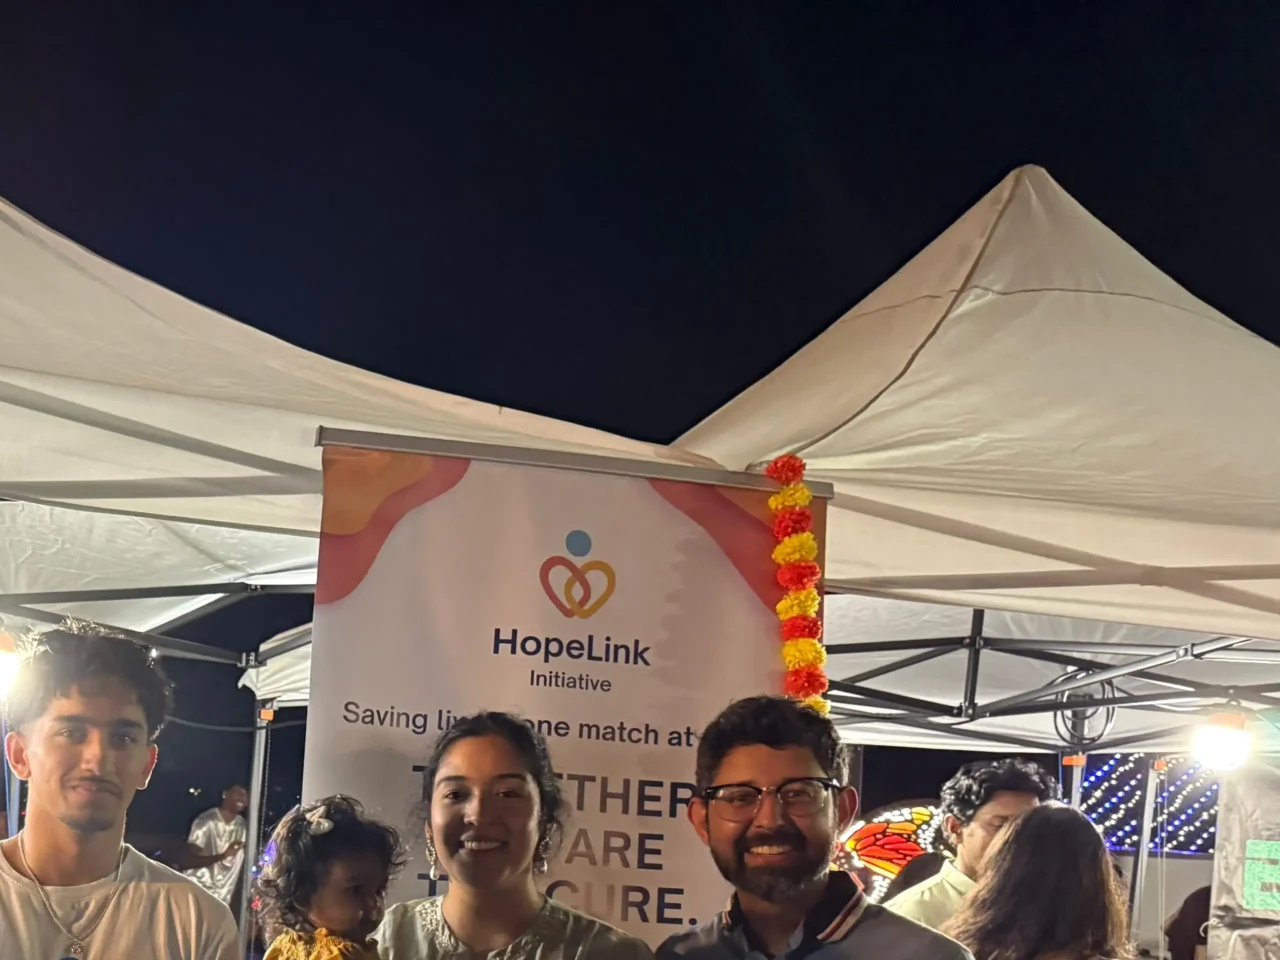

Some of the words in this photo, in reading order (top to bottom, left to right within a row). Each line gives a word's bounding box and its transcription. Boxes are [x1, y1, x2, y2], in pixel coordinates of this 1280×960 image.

[492, 628, 652, 666] HopeLink
[529, 669, 613, 693] Initiative
[342, 701, 429, 735] Saving
[578, 721, 660, 745] match
[667, 726, 694, 748] at
[564, 828, 664, 871] ARE
